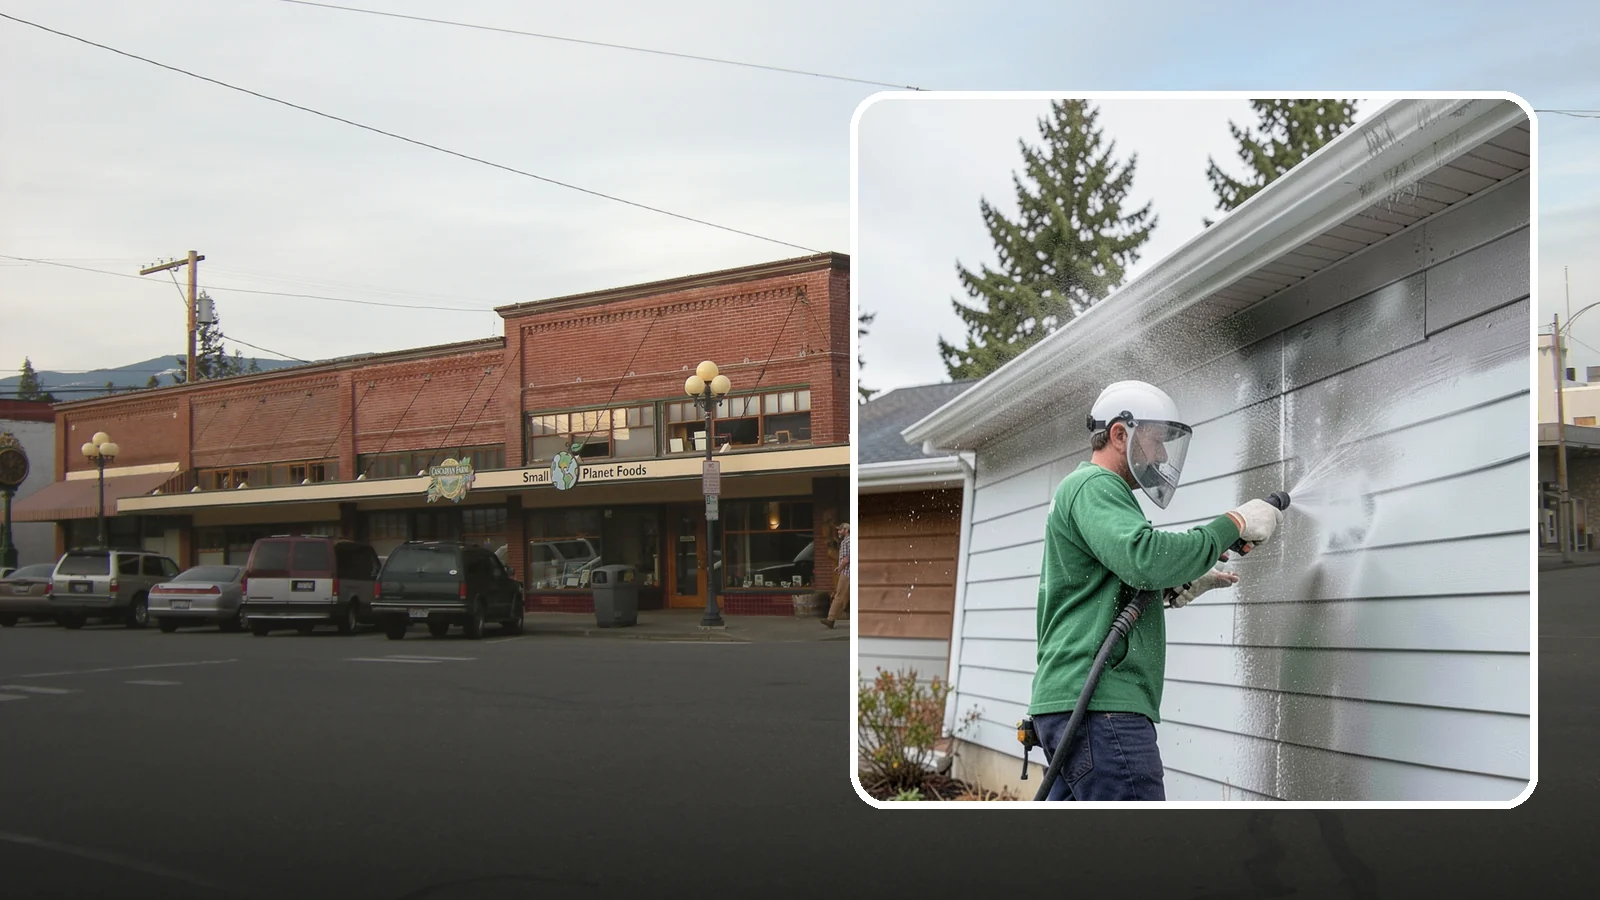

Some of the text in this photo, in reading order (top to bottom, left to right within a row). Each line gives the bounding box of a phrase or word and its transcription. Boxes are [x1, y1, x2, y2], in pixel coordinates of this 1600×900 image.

[523, 464, 647, 483] Small Planet Foods
